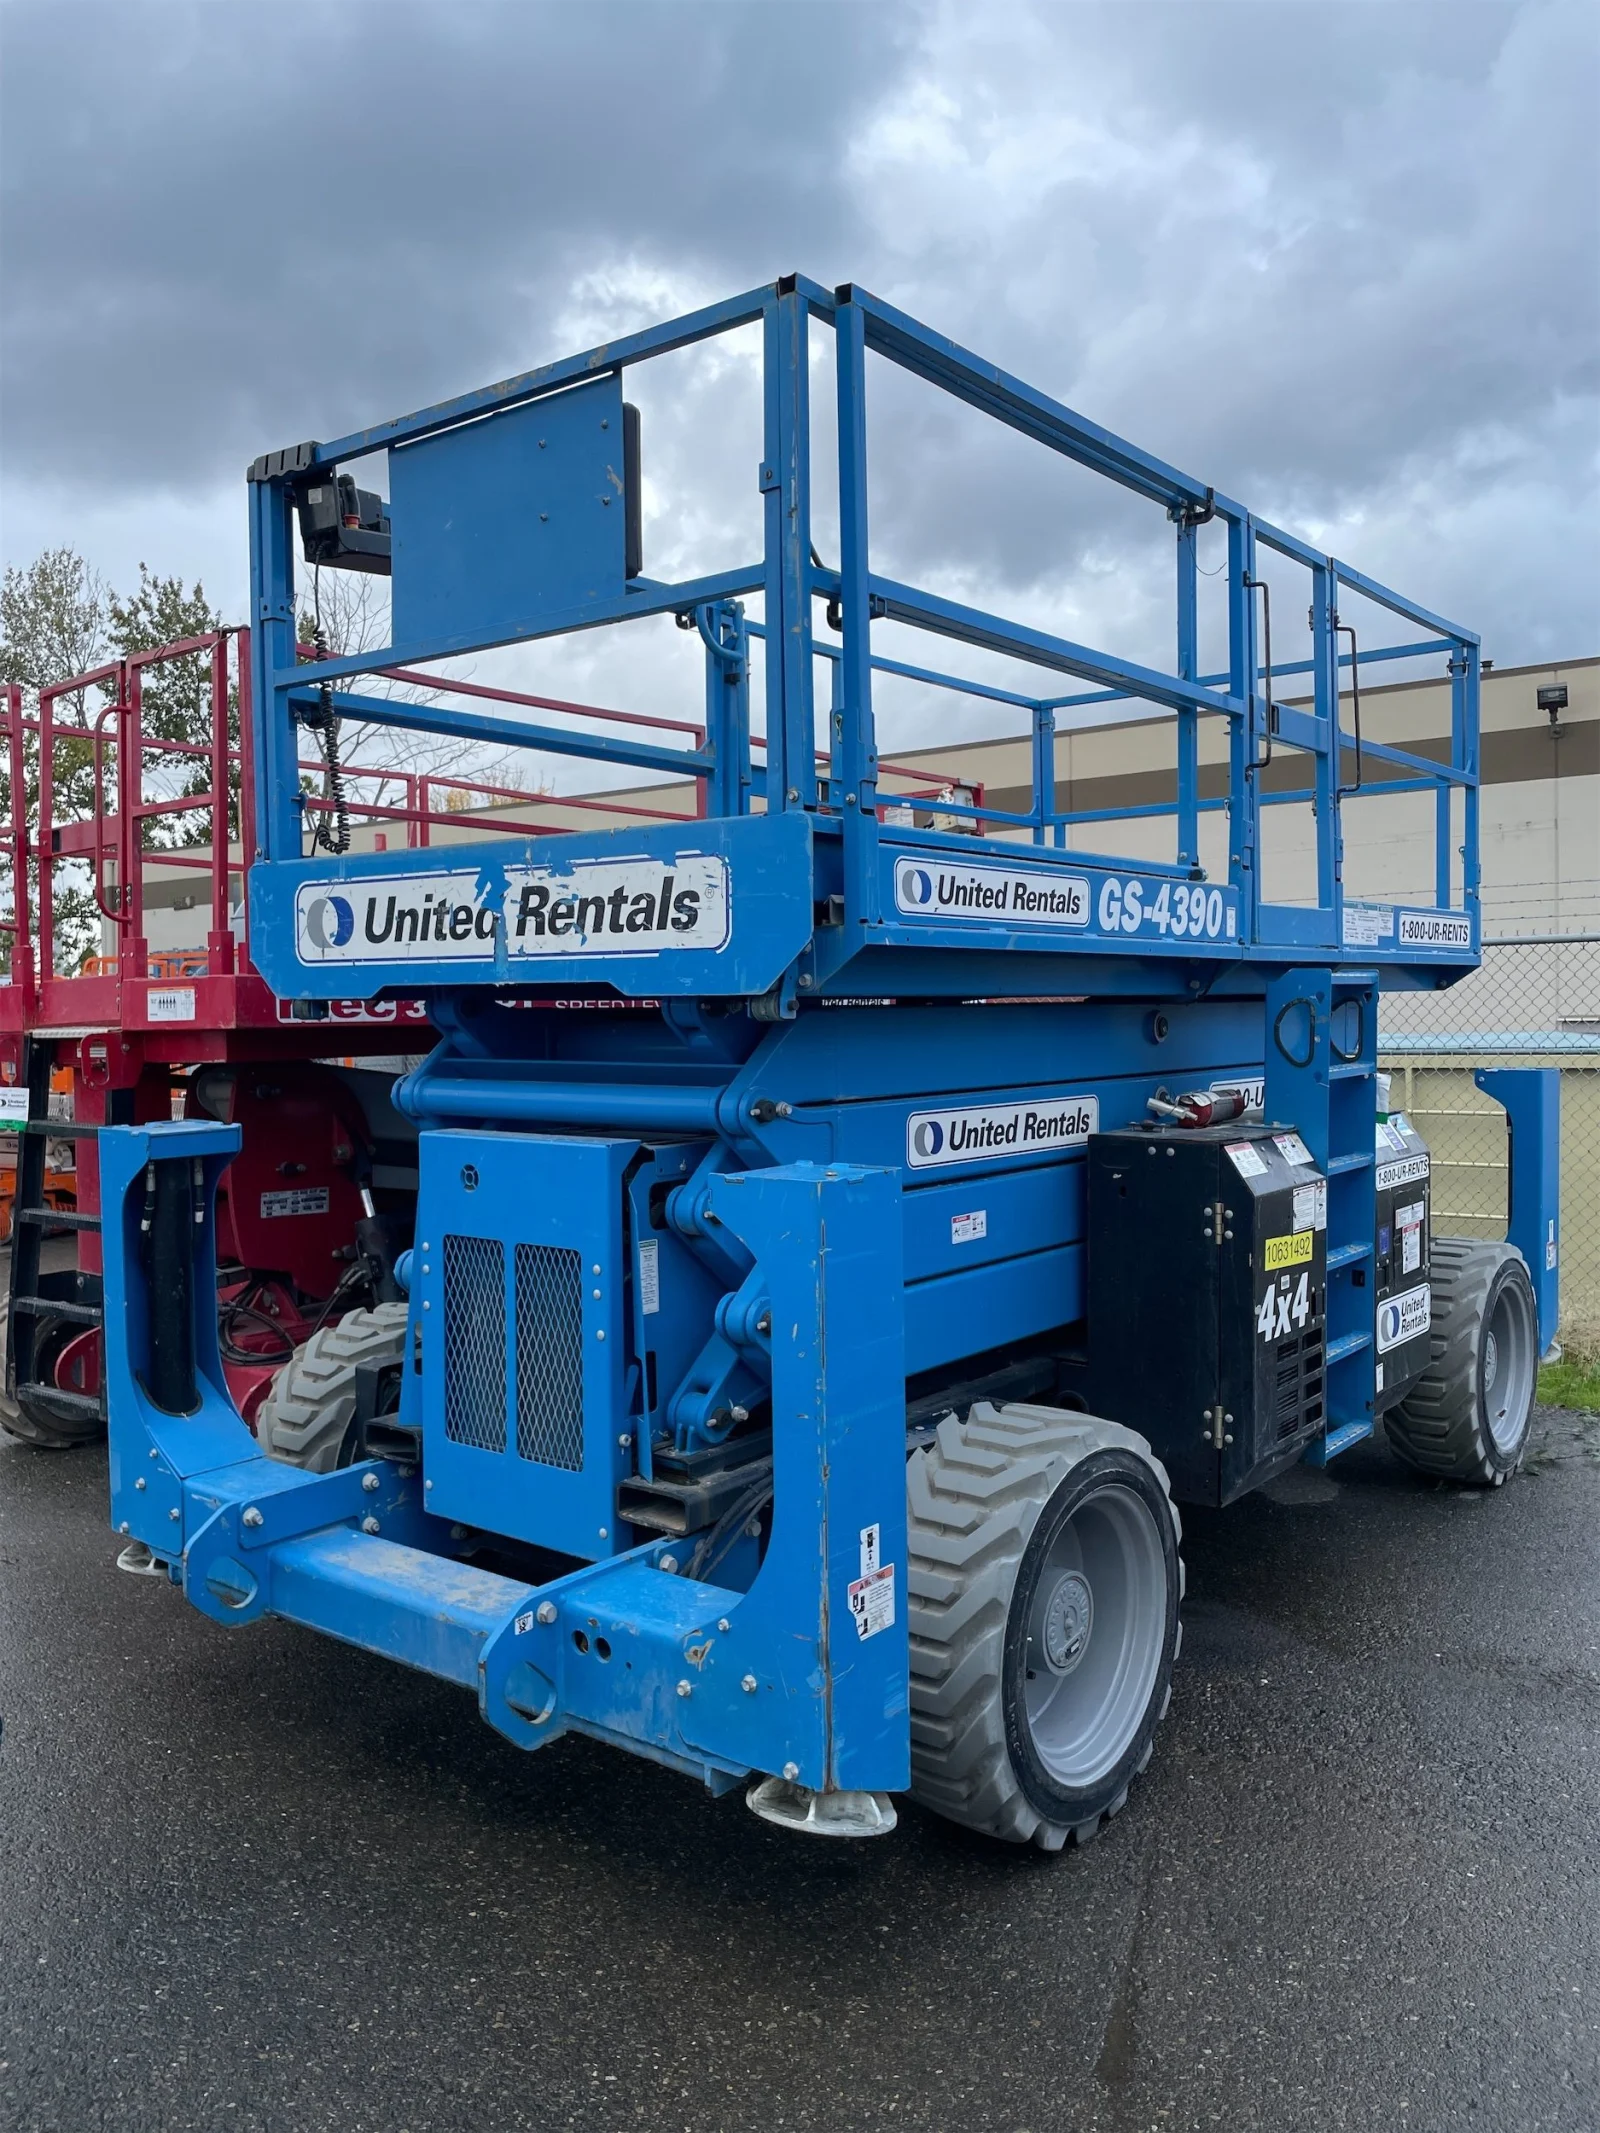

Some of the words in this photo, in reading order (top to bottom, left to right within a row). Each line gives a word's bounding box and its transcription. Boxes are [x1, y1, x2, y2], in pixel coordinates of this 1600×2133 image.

[515, 876, 700, 936] Rentals
[937, 874, 1008, 909] United
[1013, 881, 1081, 914] Rentals
[1098, 877, 1223, 938] GS-4390
[1401, 919, 1469, 942] 1-800-UR-RENTS
[949, 1113, 1020, 1151] United
[1023, 1106, 1089, 1140] Rentals
[1378, 1159, 1428, 1185] 1-800-UR-RENTS
[1266, 1236, 1311, 1264] 10631492
[1257, 1271, 1309, 1342] 4x4
[1401, 1292, 1425, 1318] United
[1401, 1311, 1428, 1335] Rentals
